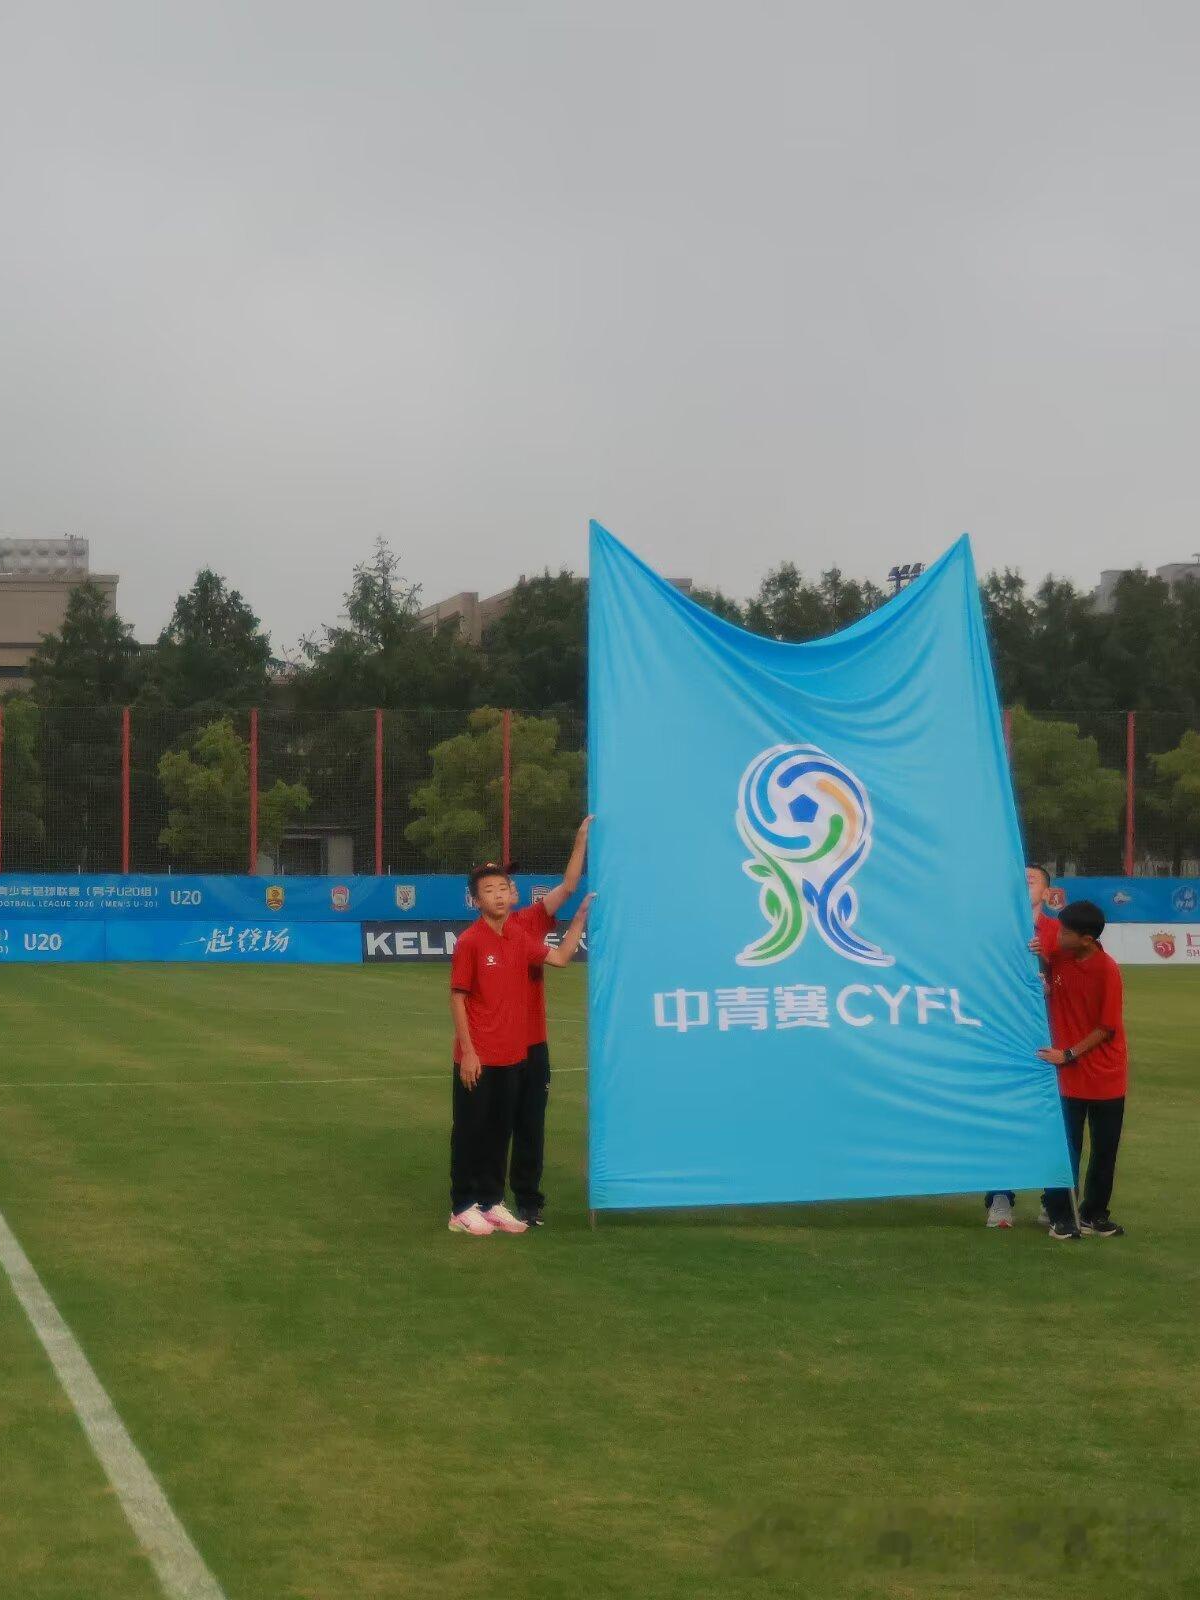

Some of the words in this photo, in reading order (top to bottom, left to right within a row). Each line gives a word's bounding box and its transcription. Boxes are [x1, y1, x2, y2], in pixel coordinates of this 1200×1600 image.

[170, 890, 201, 905] U20
[23, 933, 62, 951] U20
[653, 984, 983, 1033] 中青赛CYFL
